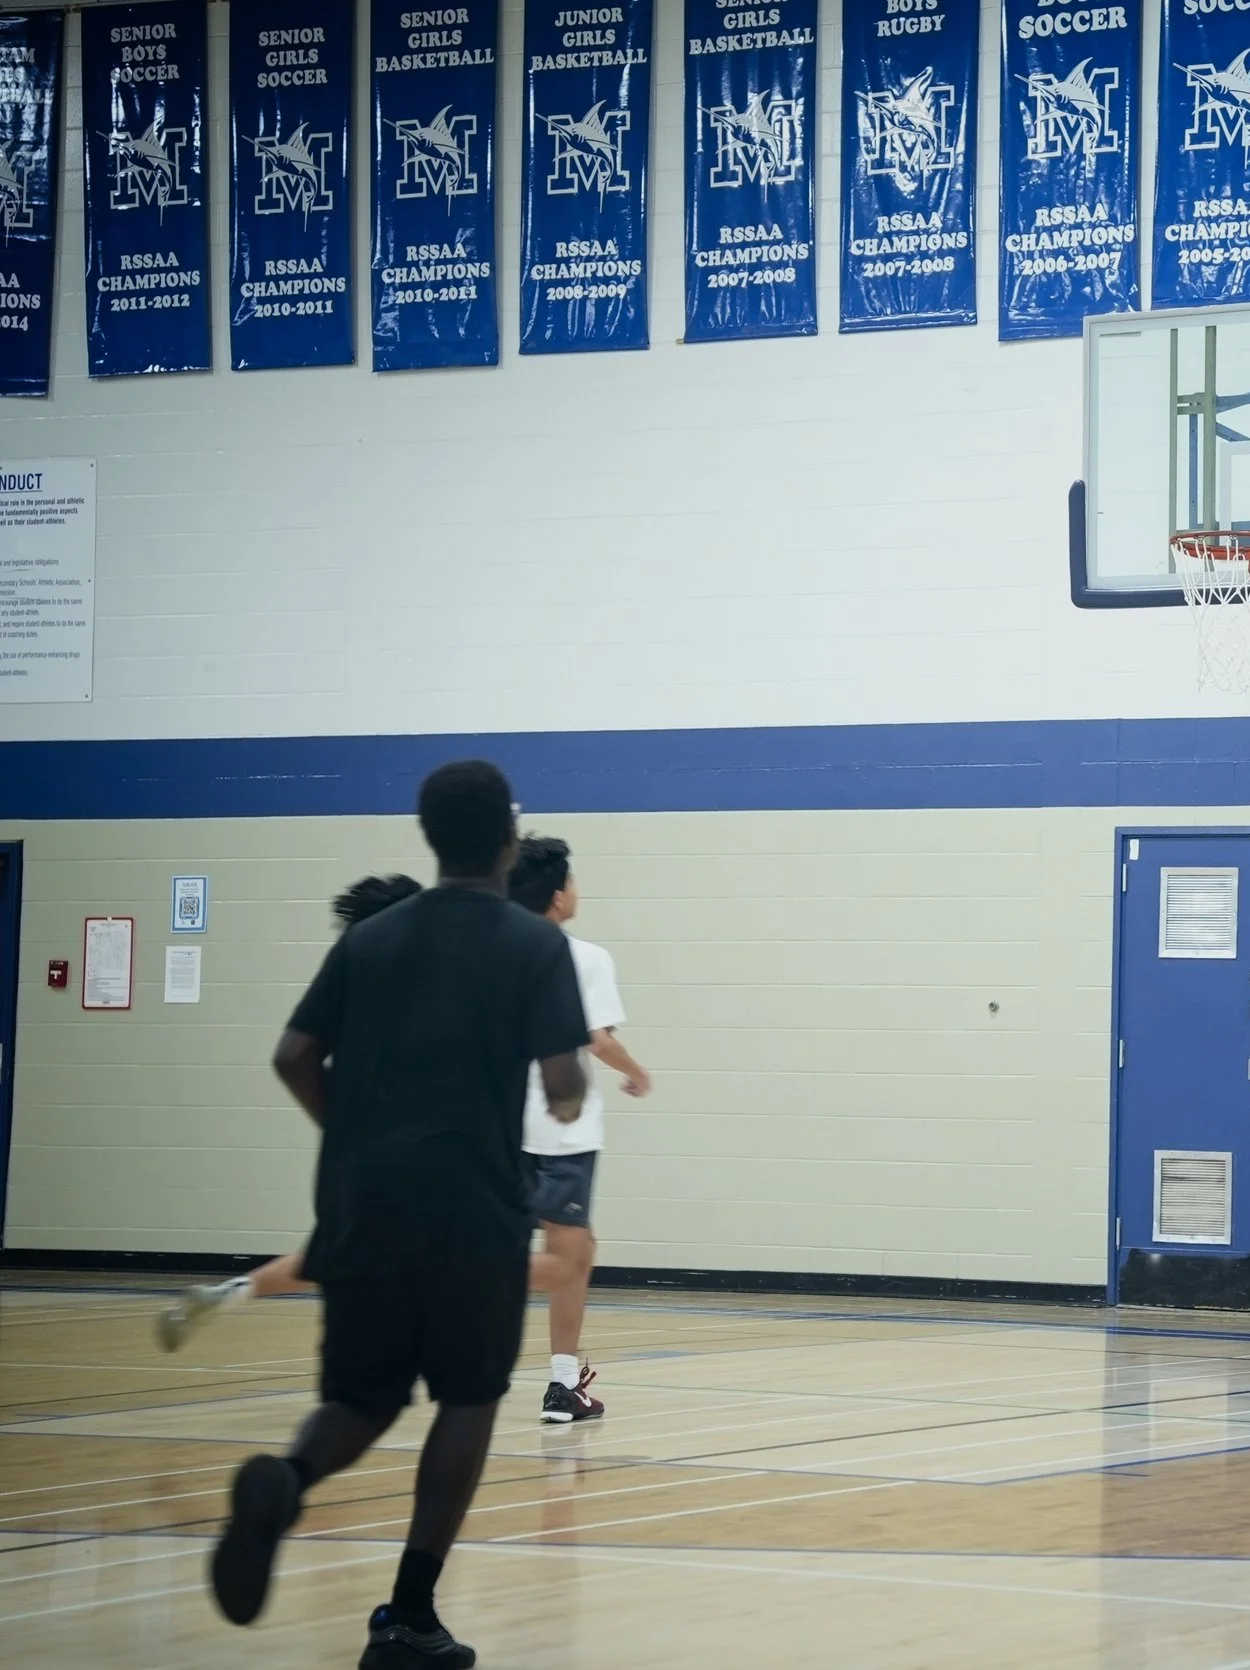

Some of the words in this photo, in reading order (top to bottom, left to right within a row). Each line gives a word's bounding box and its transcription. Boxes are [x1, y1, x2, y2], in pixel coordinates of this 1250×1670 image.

[400, 8, 470, 29] SENIOR
[554, 7, 624, 27] JUNIOR
[723, 9, 780, 29] GIRLS
[877, 14, 946, 37] RUGBY
[1018, 6, 1128, 39] SOCCER
[110, 23, 177, 43] SENIOR
[259, 27, 325, 47] SENIOR
[407, 29, 463, 49] GIRLS
[562, 29, 616, 48] GIRLS
[689, 28, 814, 55] BASKETBALL
[121, 44, 167, 62] BOYS
[265, 48, 318, 67] GIRLS
[375, 48, 495, 72] BASKETBALL
[531, 48, 647, 71] BASKETBALL
[110, 64, 180, 84] SOCCER
[257, 68, 328, 88] SOCCER
[877, 213, 942, 234] RSSAA
[1034, 203, 1109, 228] RSSAA
[719, 224, 783, 244] RSSAA
[850, 231, 968, 256] CHAMPIONS
[1005, 225, 1135, 252] CHAMPIONS
[405, 242, 466, 262] RSSAA
[555, 238, 619, 258] RSSAA
[695, 244, 809, 267] CHAMPIONS
[120, 252, 179, 270] RSSAA
[264, 257, 324, 277] RSSAA
[530, 259, 641, 281] CHAMPIONS
[862, 256, 955, 278] 2007-2008
[1019, 251, 1122, 276] 2006-2007
[97, 270, 201, 292] CHAMPIONS
[381, 261, 490, 284] CHAMPIONS
[707, 267, 796, 288] 2007-2008
[240, 277, 346, 298] CHAMPIONS
[395, 285, 478, 304] 2010-2011
[545, 282, 627, 301] 2008-2009
[110, 293, 190, 312] 2011-2012
[254, 299, 334, 318] 2010-2011
[0, 473, 43, 490] NDUCT
